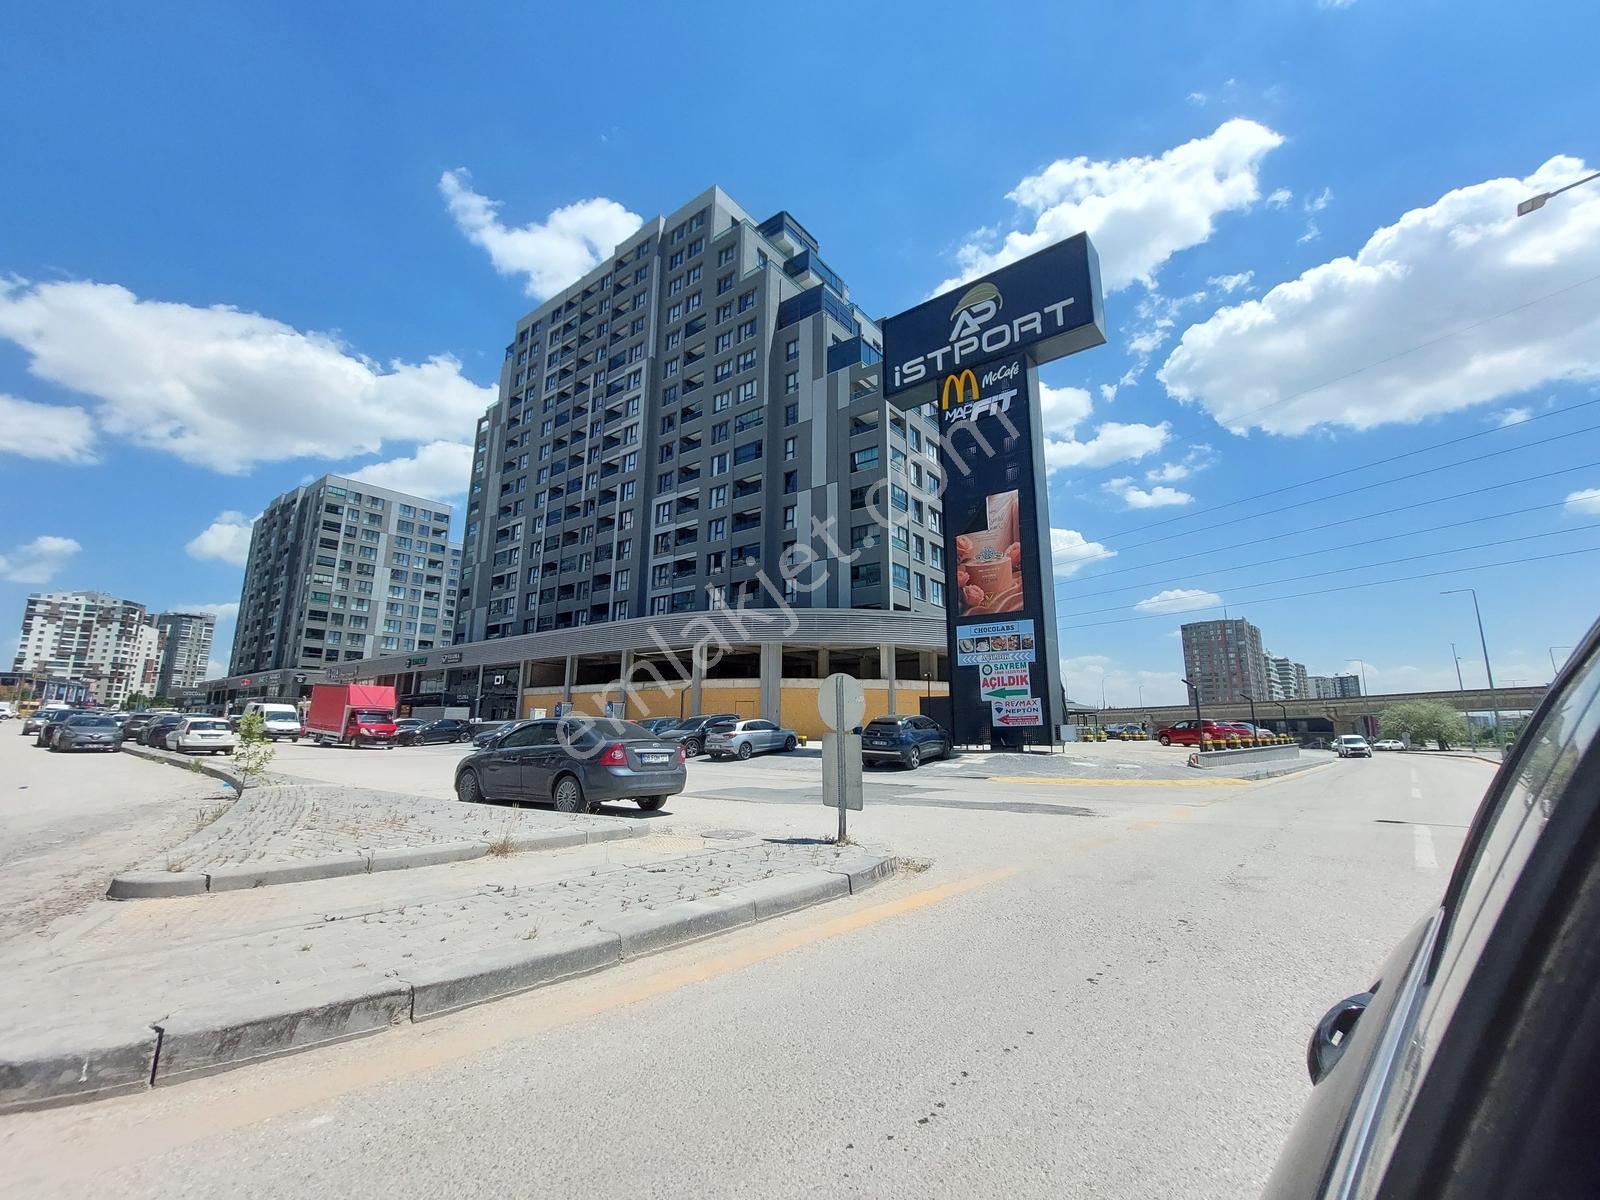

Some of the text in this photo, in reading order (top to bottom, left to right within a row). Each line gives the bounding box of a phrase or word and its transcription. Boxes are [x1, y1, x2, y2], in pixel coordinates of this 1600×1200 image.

[982, 361, 1020, 389] McCafé
[973, 625, 1015, 634] CHOCOLABS
[993, 662, 1027, 671] SAYREM
[981, 675, 1029, 690] AÇILDIK
[1005, 700, 1037, 708] RE/MAX
